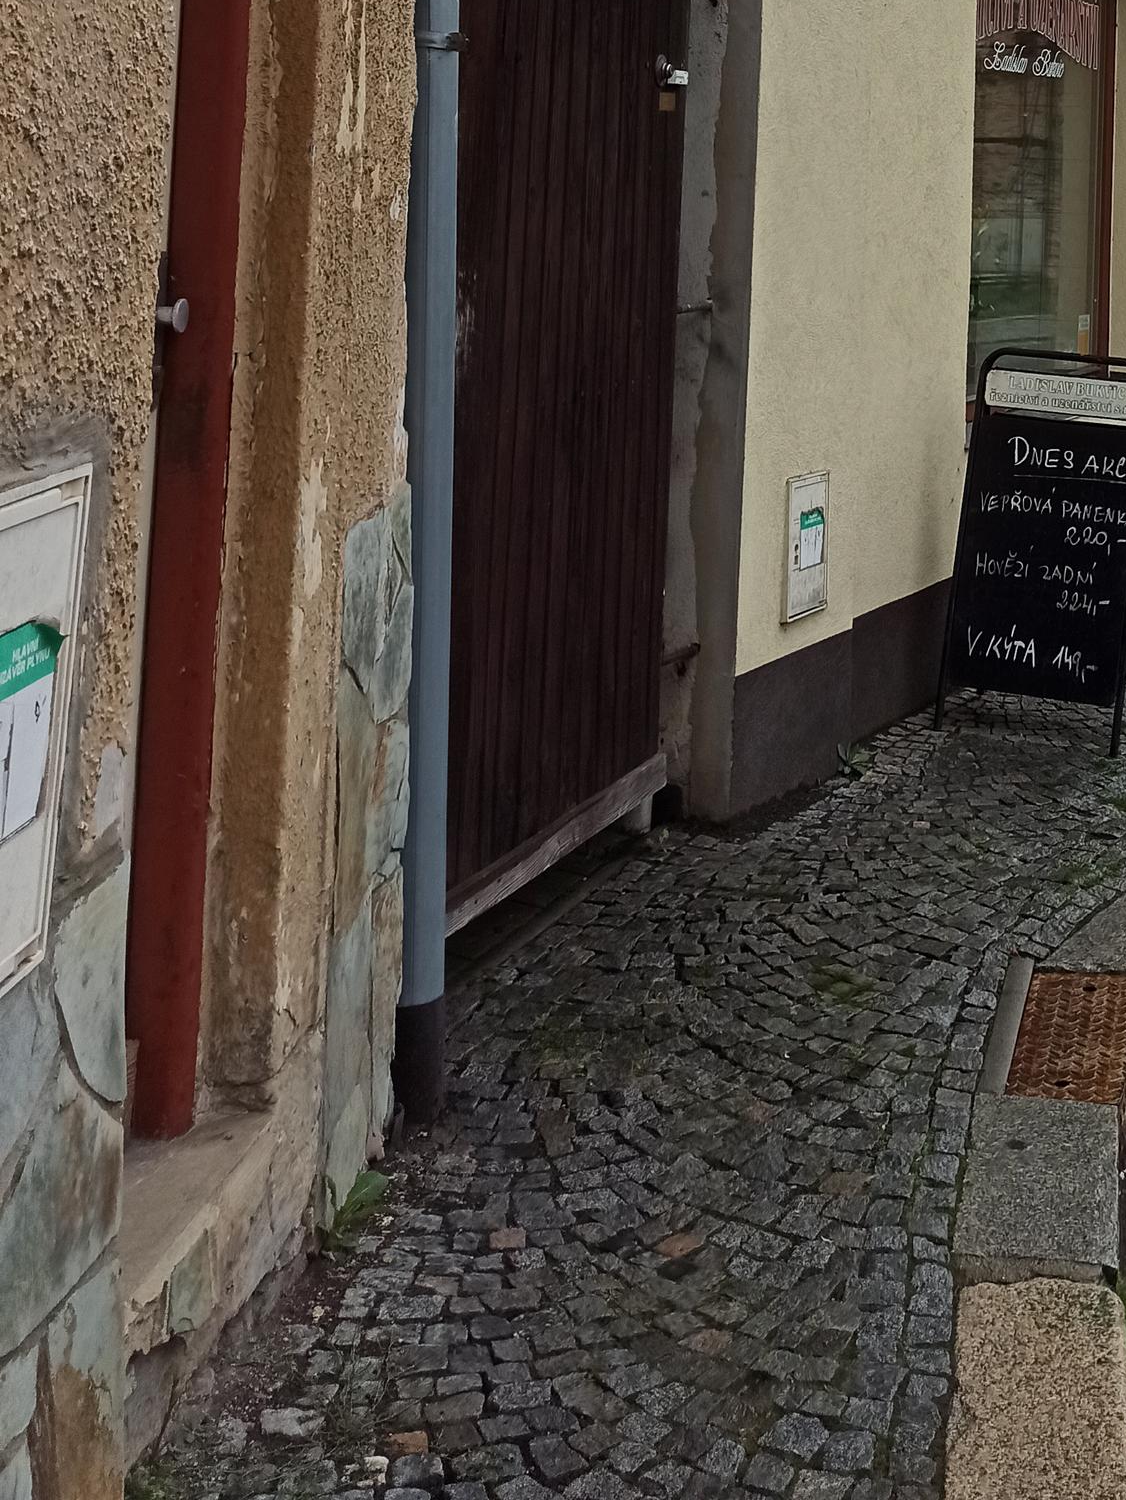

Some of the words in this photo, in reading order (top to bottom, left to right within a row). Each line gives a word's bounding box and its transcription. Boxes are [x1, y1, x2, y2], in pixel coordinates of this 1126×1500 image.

[1009, 376, 1075, 397] LADISLAV
[1041, 397, 1049, 406] a
[1008, 436, 1074, 469] DNES
